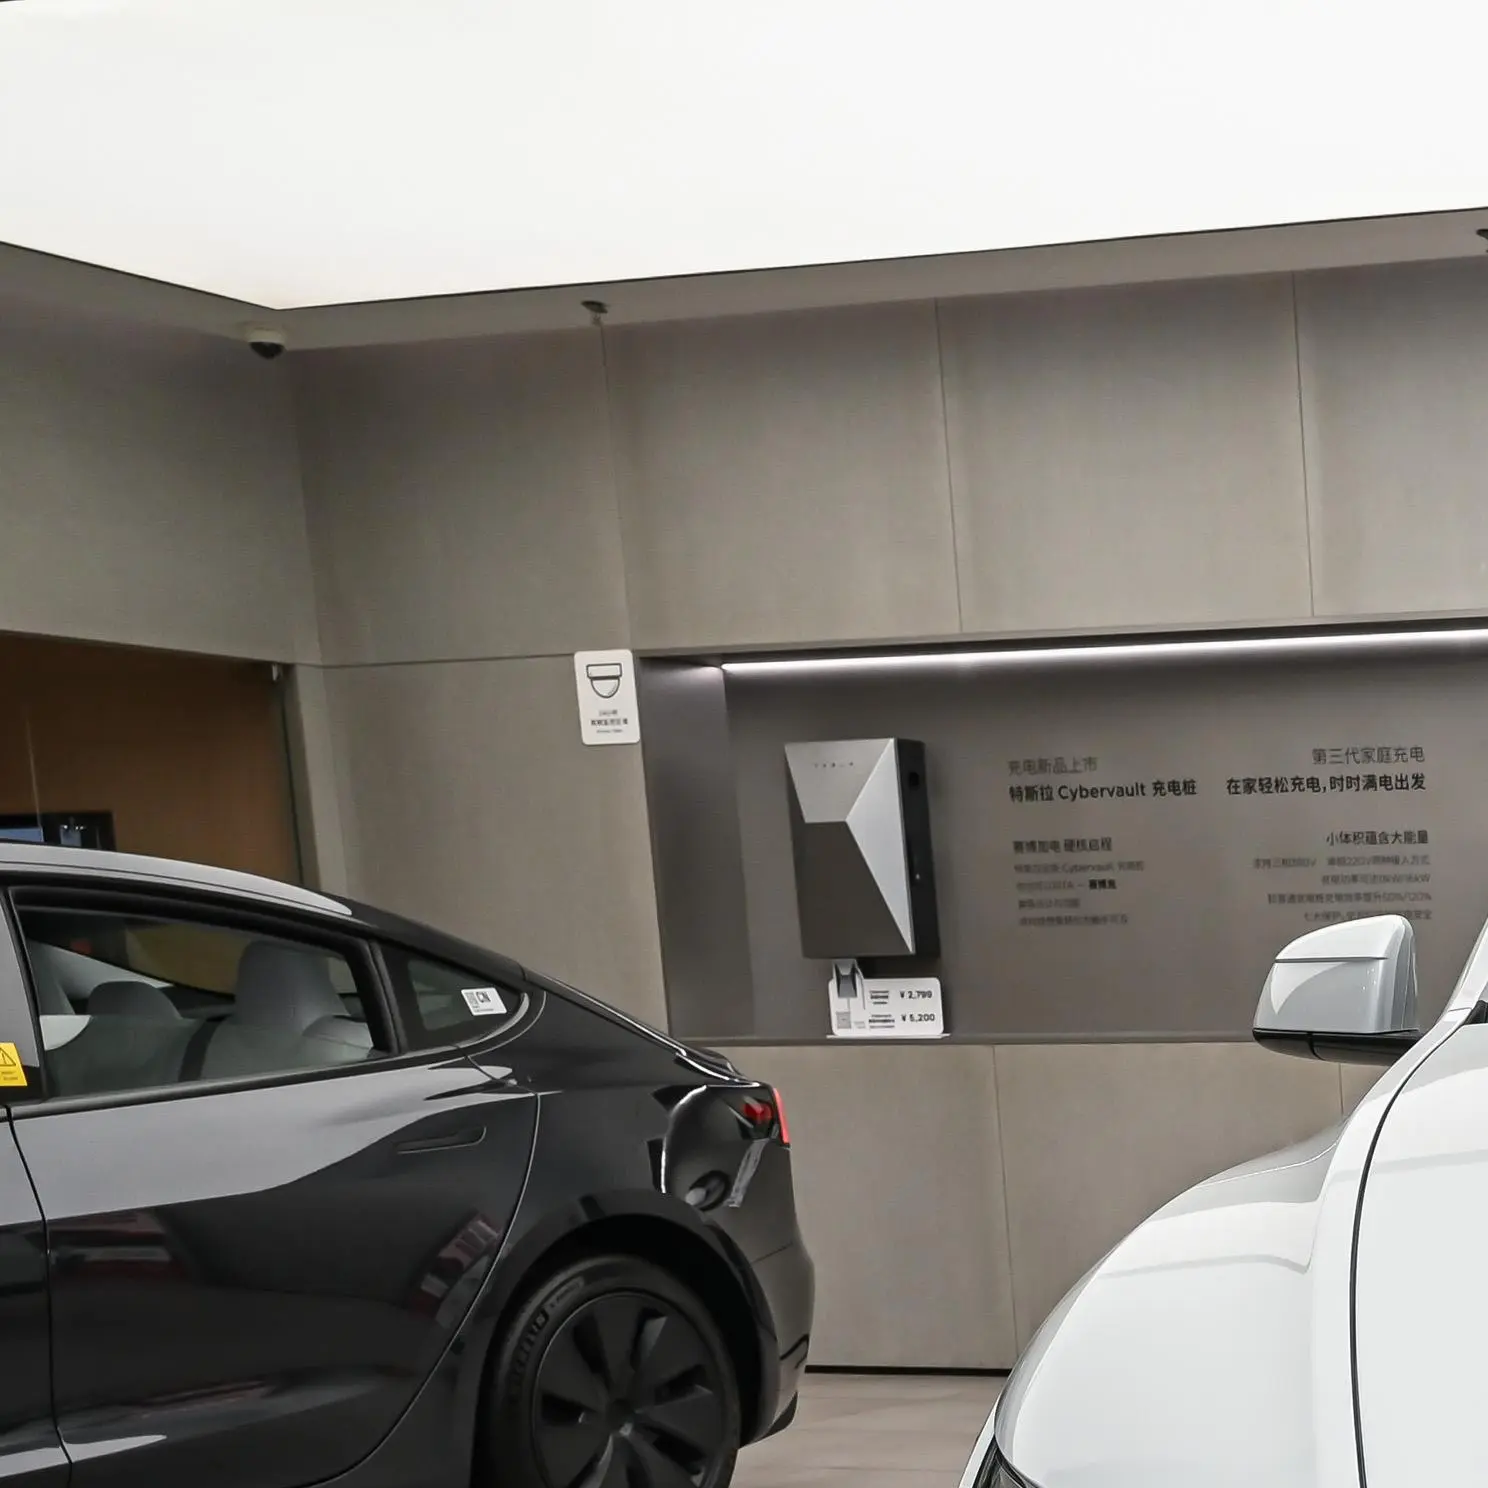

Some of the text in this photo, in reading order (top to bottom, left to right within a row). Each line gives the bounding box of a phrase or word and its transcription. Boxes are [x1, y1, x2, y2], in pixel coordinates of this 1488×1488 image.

[1007, 756, 1098, 775] 充电新品上市
[1312, 746, 1425, 765] 第三代家庭充电
[1009, 779, 1198, 802] 特斯拉 Cybervault 充电桩
[1226, 773, 1427, 795] 在家轻松充电，时时满电出发
